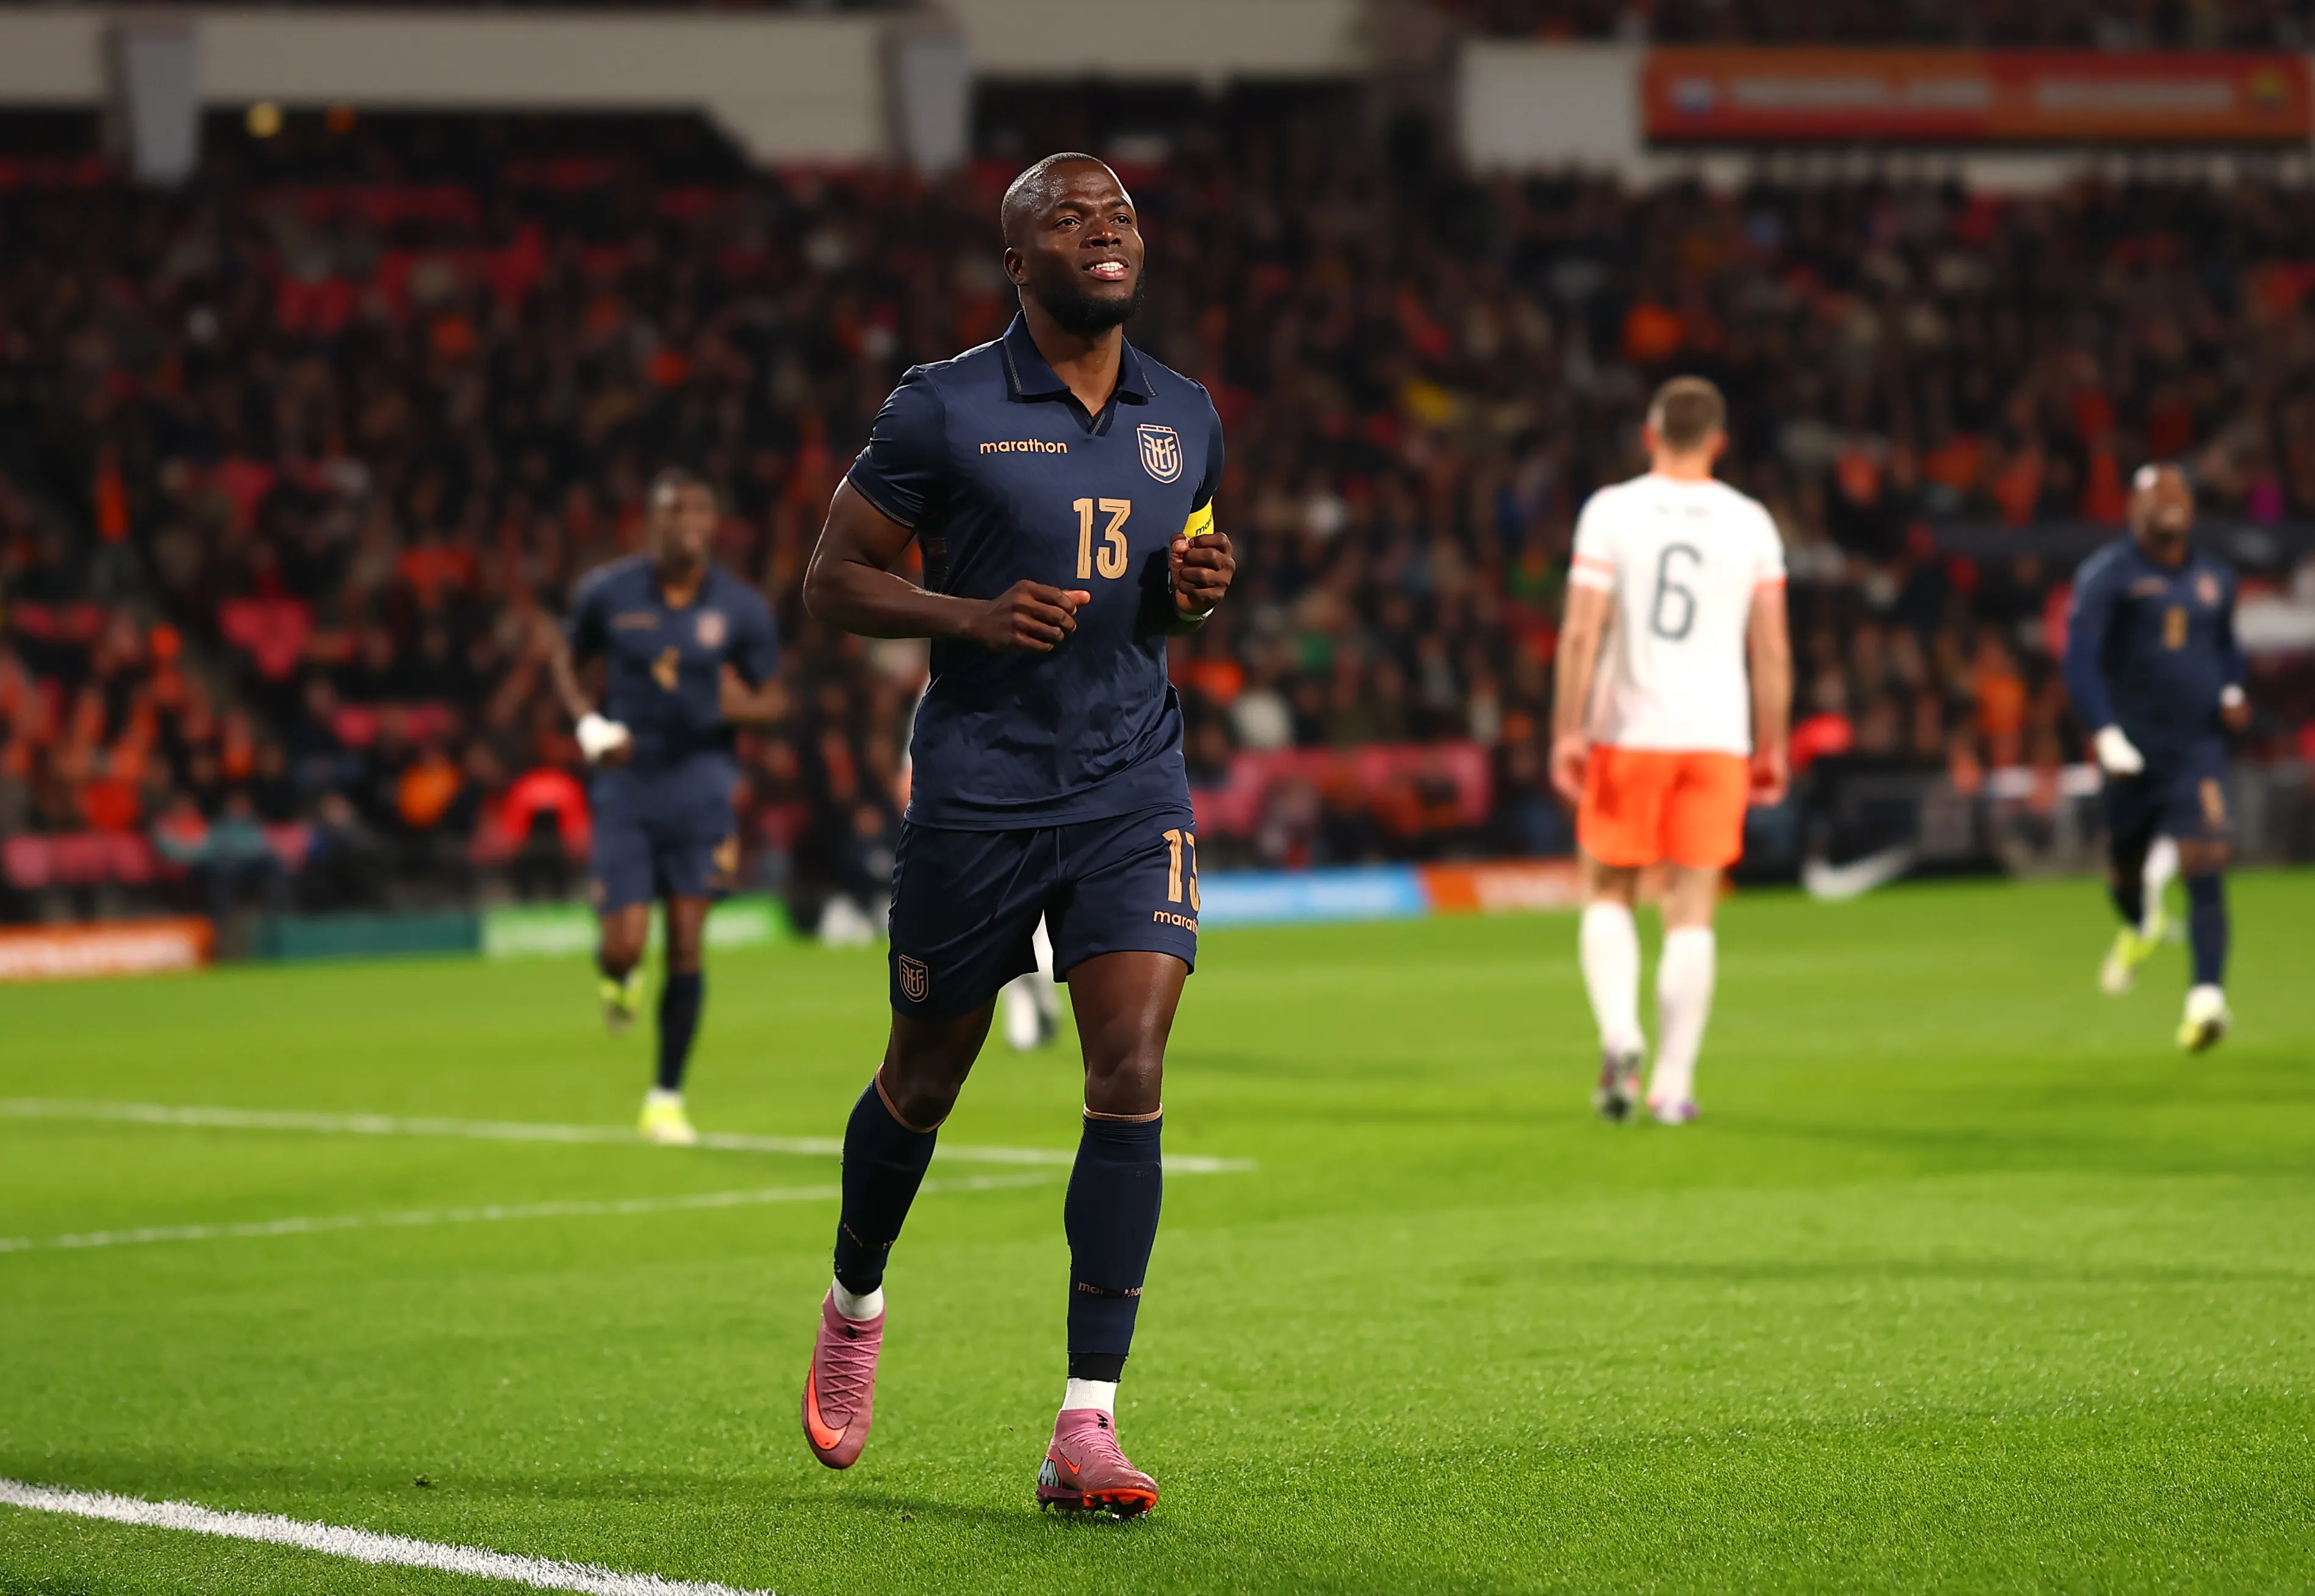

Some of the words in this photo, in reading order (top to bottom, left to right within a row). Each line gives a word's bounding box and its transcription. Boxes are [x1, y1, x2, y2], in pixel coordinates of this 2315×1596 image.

[980, 438, 1068, 454] marathon
[1073, 498, 1130, 579] 13
[1649, 542, 1702, 642] 6
